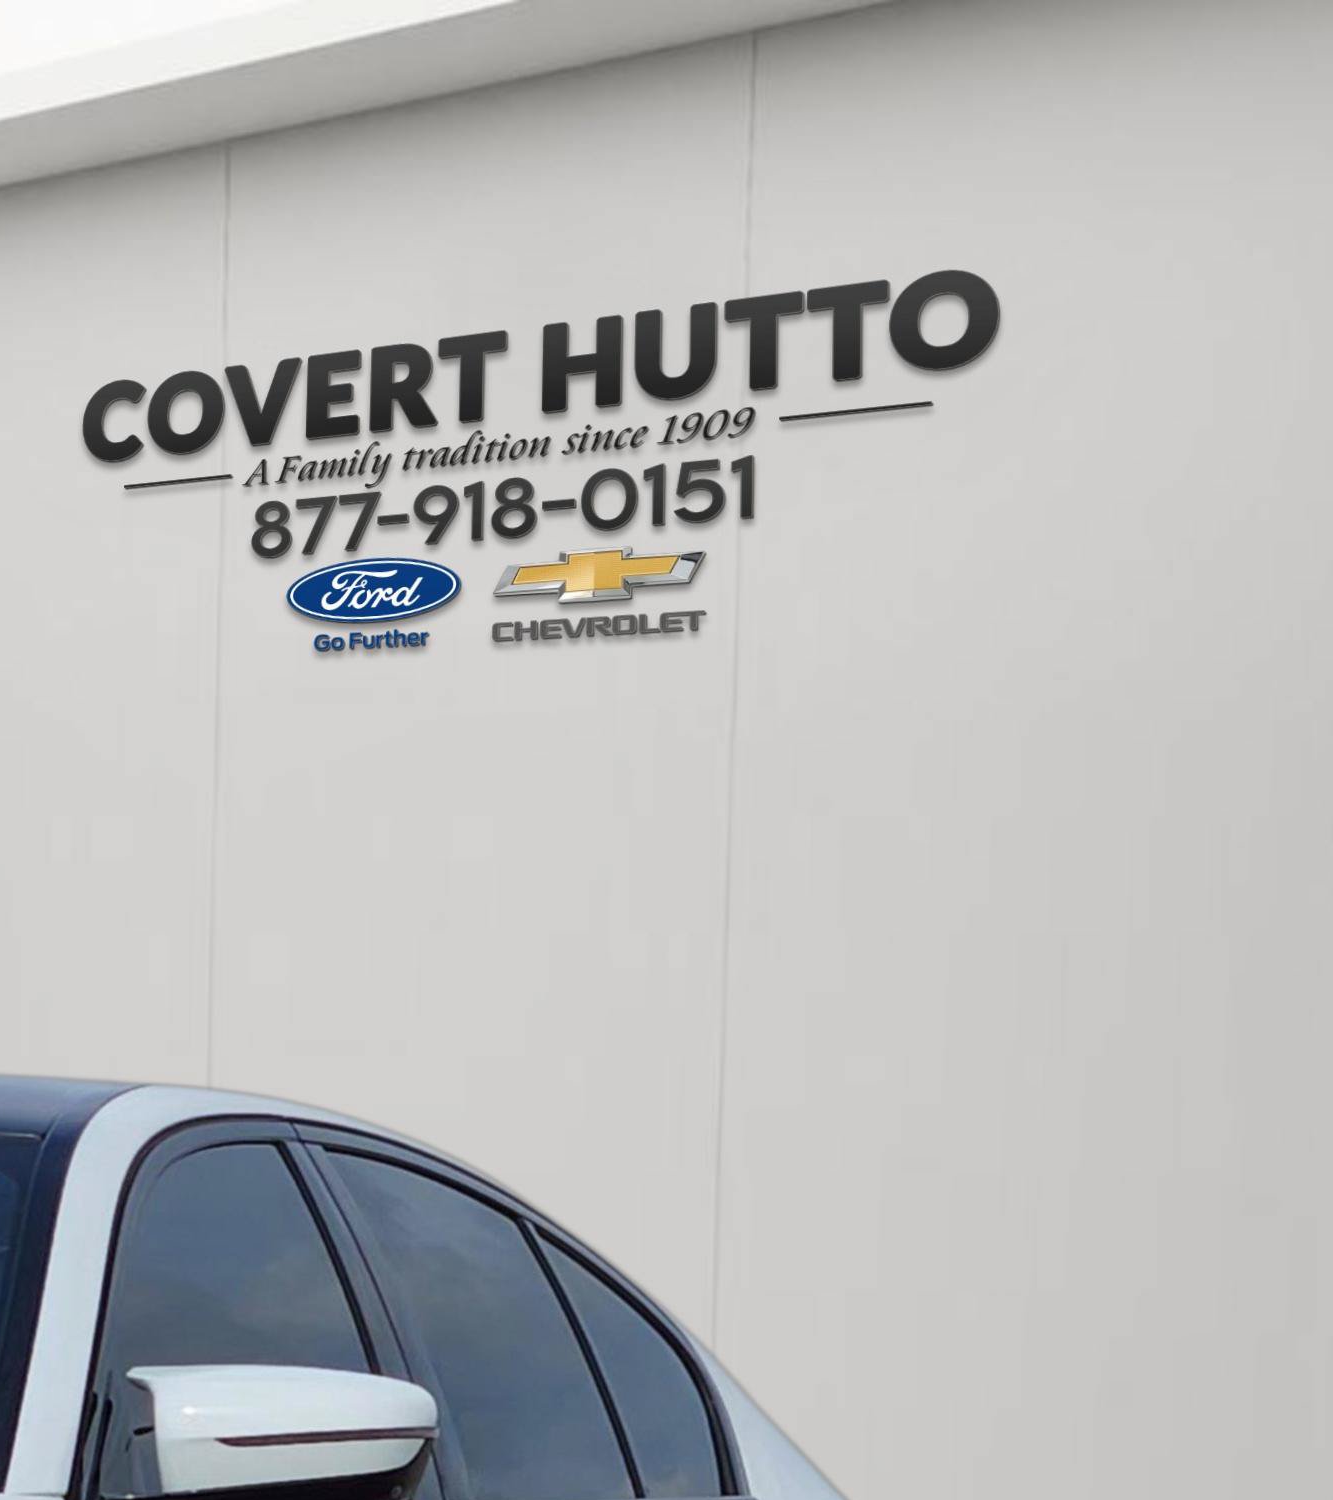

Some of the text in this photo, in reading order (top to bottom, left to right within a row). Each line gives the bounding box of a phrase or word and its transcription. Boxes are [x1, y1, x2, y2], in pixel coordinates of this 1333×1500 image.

[83, 270, 1001, 464] COVERT HUTTO
[243, 407, 756, 490] A Family tradition since 1909
[251, 455, 755, 560] 877-918-0151
[320, 568, 423, 611] Ford
[313, 629, 430, 653] Go Further
[491, 610, 707, 643] CHEVROLET
